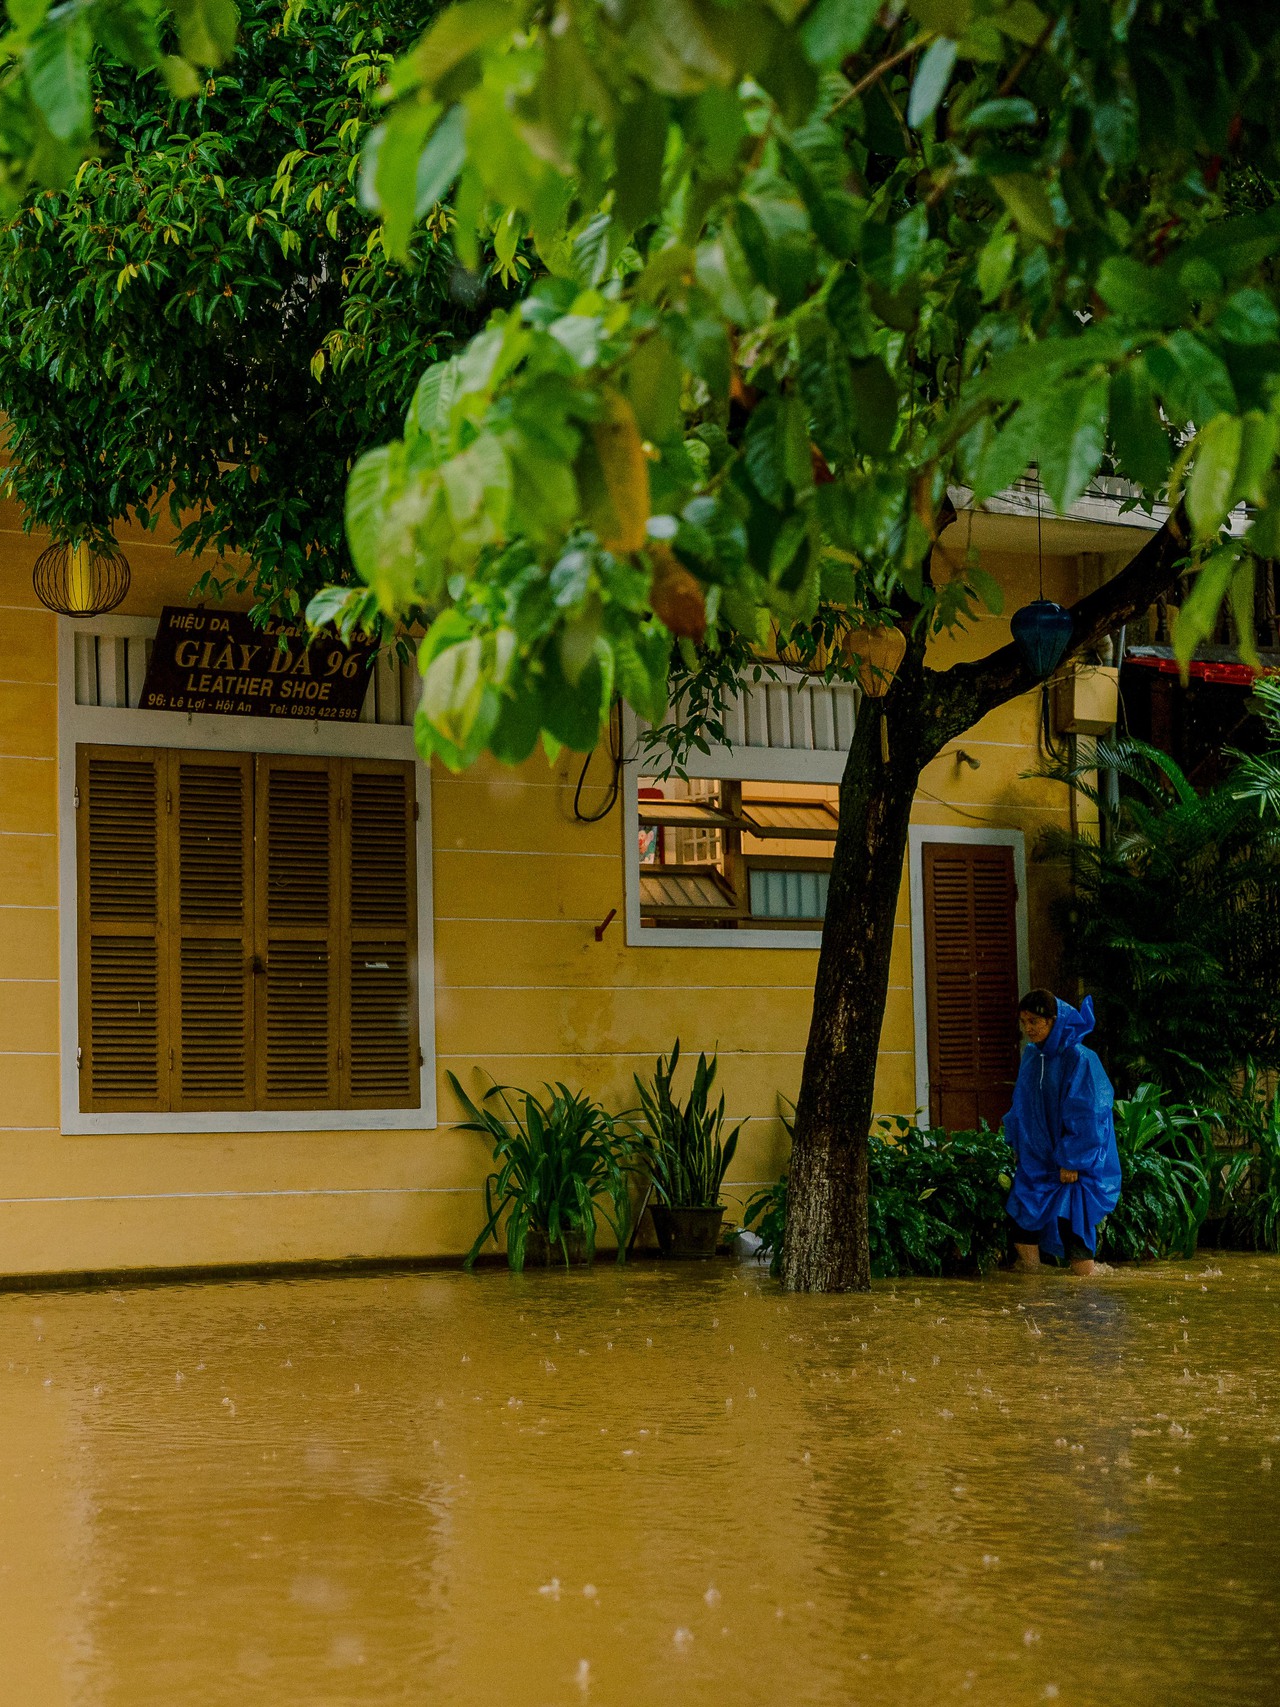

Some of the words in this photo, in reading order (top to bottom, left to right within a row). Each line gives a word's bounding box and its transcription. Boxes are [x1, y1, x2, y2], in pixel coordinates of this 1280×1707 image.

[169, 613, 205, 632] HIỆU
[210, 618, 230, 632] DA
[175, 634, 261, 671] GIÀY
[268, 647, 312, 675] DA
[323, 650, 362, 678] 96
[186, 673, 273, 697] LEATHER
[280, 680, 332, 700] SHOE
[148, 693, 166, 706] 96:
[170, 697, 184, 707] Lê
[187, 698, 206, 711] Lợi
[215, 700, 234, 713] Hội
[237, 701, 252, 712] An
[269, 703, 288, 715] Tel:
[291, 705, 316, 716] 0935
[318, 707, 338, 718] 422
